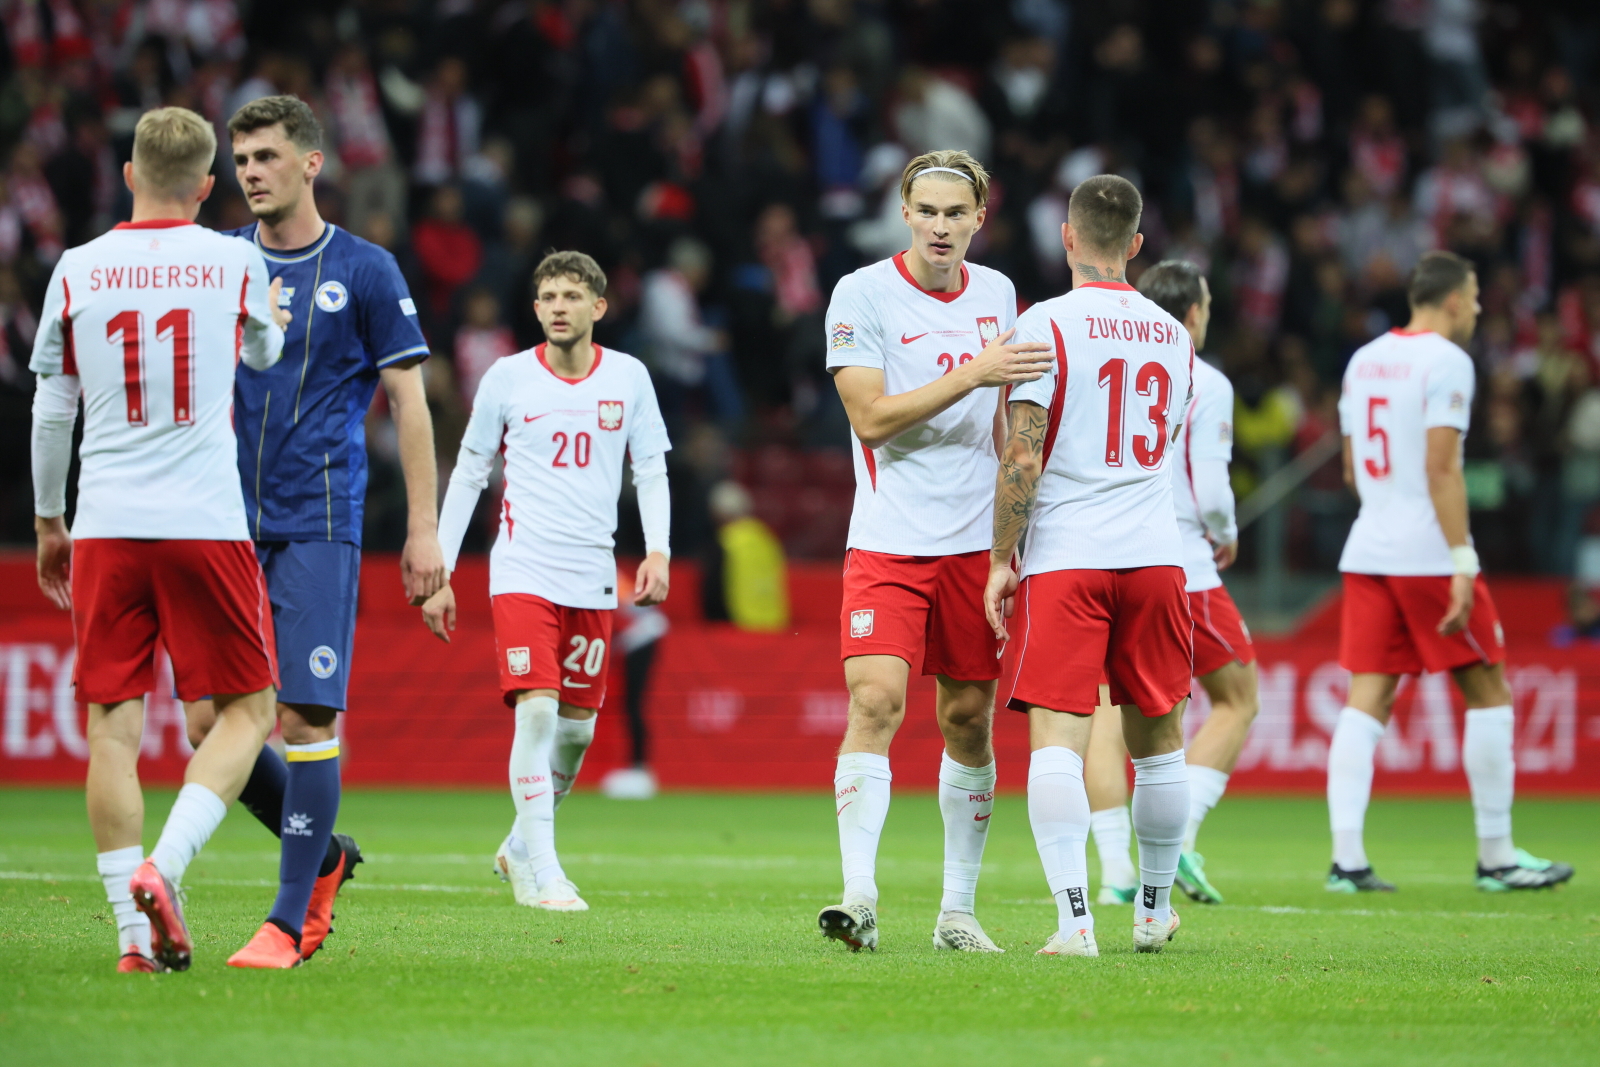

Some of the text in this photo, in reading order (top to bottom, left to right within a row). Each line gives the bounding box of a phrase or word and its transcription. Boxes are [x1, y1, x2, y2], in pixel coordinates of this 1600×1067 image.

[90, 264, 224, 291] ŚWIDERSKI
[106, 308, 195, 427] 11
[1098, 358, 1172, 472] 13
[551, 431, 592, 468] 20
[1363, 397, 1392, 480] 5
[562, 634, 606, 678] 20
[516, 775, 547, 786] POLSKA
[969, 790, 994, 803] POLS
